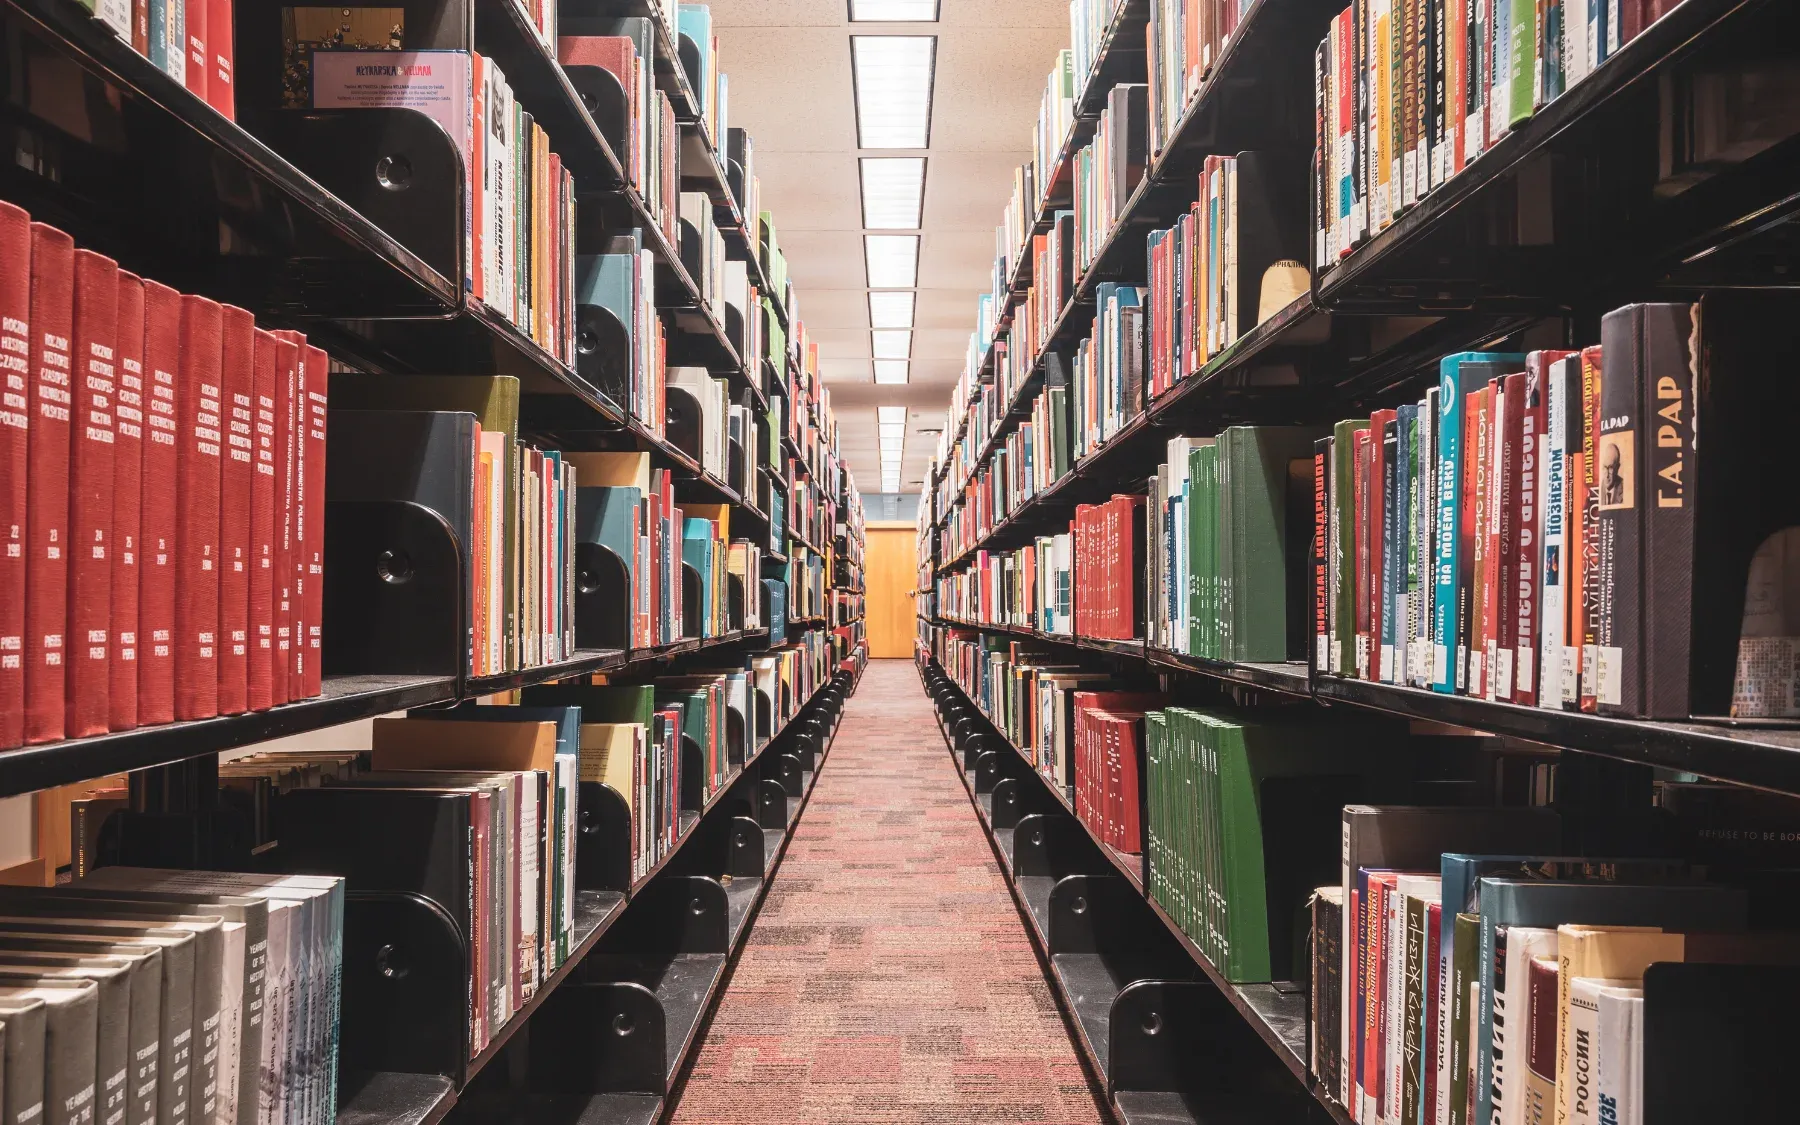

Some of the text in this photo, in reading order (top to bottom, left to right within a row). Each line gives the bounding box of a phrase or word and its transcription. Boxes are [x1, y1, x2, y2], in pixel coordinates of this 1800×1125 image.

[403, 65, 432, 76] WELLMAN
[1435, 9, 1443, 105] по имени
[1583, 363, 1594, 484] ВЕЛИКАЯ СИЛА ЛЮБВИ
[1315, 453, 1325, 558] КОНДРАШОВ
[1475, 409, 1487, 561] БОРИС ПОЛЕВОЙ
[1520, 415, 1534, 523] ПОЗНЕР
[1550, 448, 1563, 536] ПОЗНЕРОМ
[1408, 476, 1418, 576] Я репортёр
[1441, 438, 1455, 585] НА МОЕМ ВЕКУ...
[1502, 512, 1510, 555] СУДЬБЕ
[1382, 544, 1391, 640] ПОДОБНЫЕ
[1587, 486, 1600, 628] ПУШКИНОЙ
[1605, 518, 1615, 614] истории отчет»
[1699, 830, 1775, 841] REFUSE TO BE
[252, 957, 260, 968] OF
[1358, 902, 1366, 996] ЕВГЕНИЙ РУБИН
[1370, 889, 1379, 1029] открытым текстом
[1405, 912, 1423, 989] ЖИЗНИ
[1562, 955, 1570, 1002] Russian
[255, 985, 261, 995] OF
[1438, 956, 1447, 1072] ЧАСТНАЯ ЖИЗНЬ
[139, 1066, 147, 1079] OF
[174, 1051, 181, 1064] OF
[205, 1034, 213, 1048] OF
[209, 1065, 215, 1079] OF
[1559, 1006, 1569, 1074] Journalism
[1576, 1028, 1590, 1117] РОССИИ
[69, 1114, 79, 1125] OF
[108, 1095, 115, 1108] OF
[144, 1100, 151, 1112] OF
[177, 1084, 184, 1097] OF
